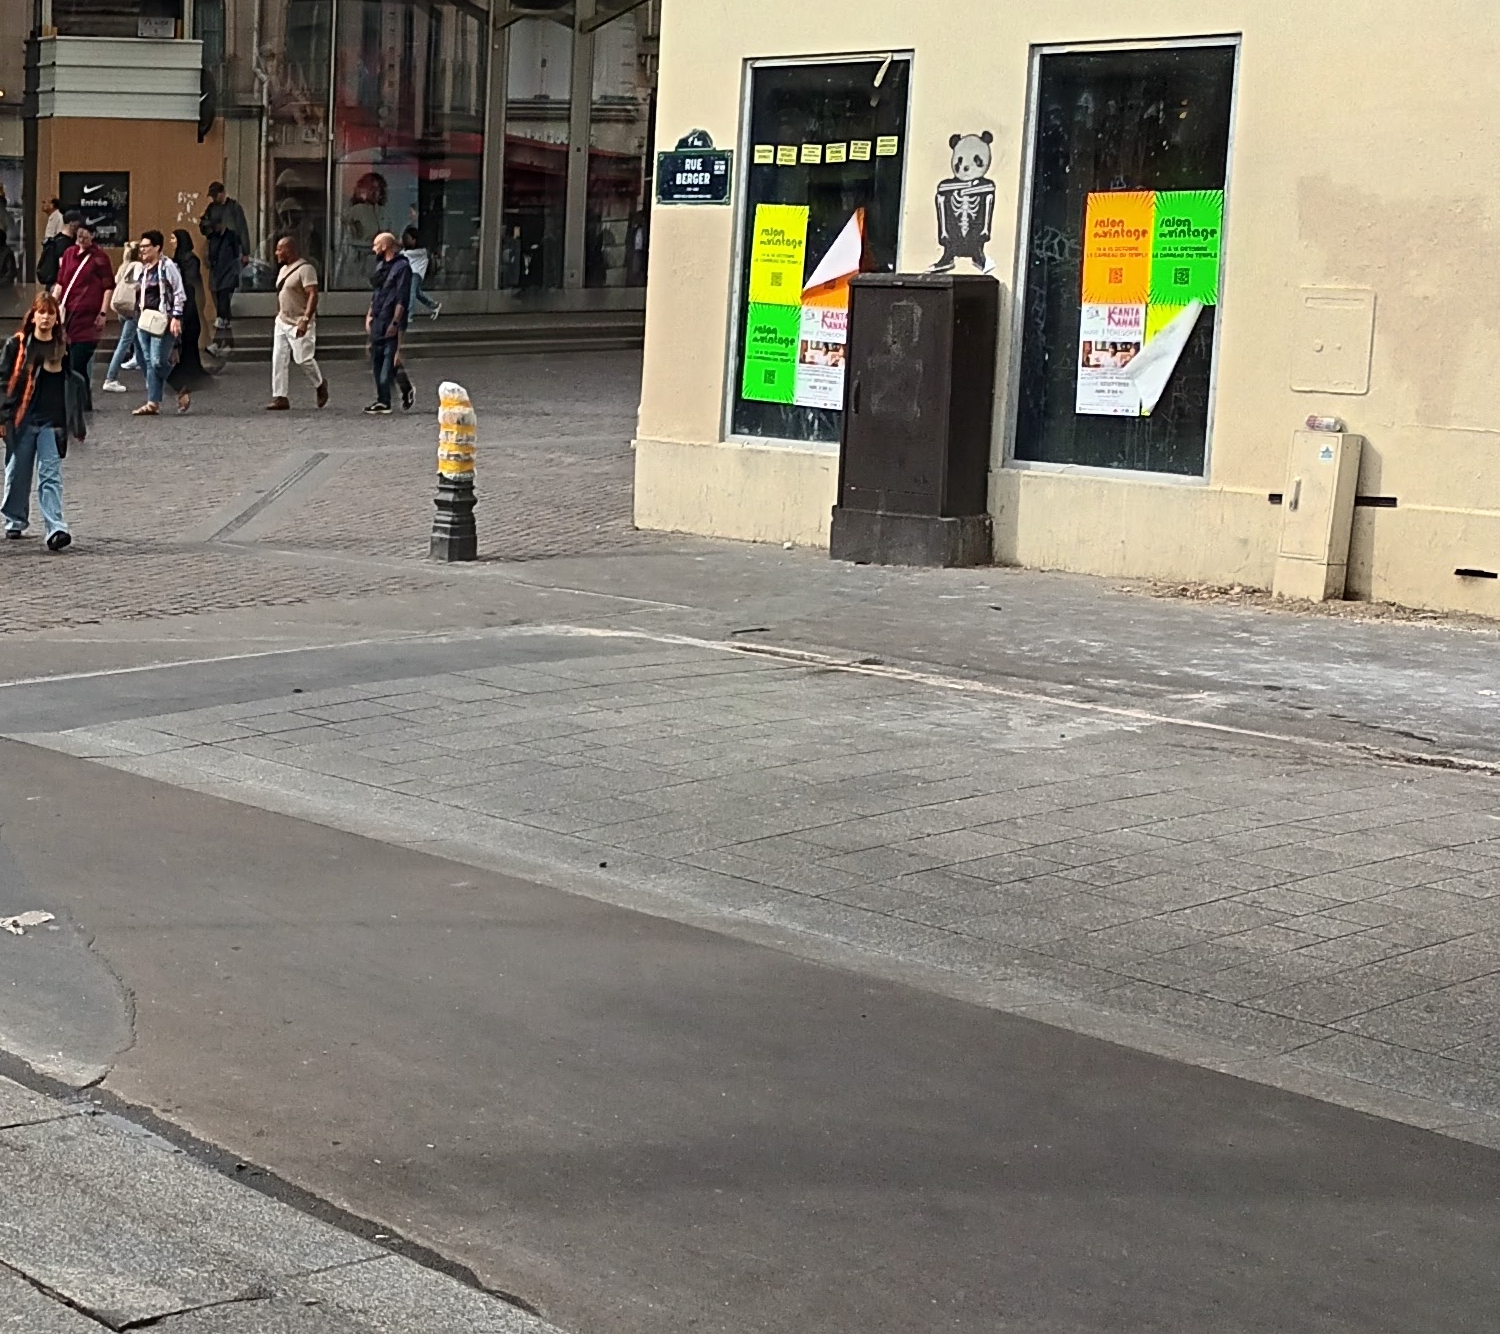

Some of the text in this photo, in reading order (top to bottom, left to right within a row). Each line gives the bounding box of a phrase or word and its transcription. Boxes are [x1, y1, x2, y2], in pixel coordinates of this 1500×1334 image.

[685, 158, 703, 171] RUE
[675, 172, 711, 185] BERGER
[80, 197, 108, 207] Entrée
[1094, 217, 1125, 229] salon
[1159, 216, 1191, 229] salon
[1102, 228, 1149, 241] vintage
[1167, 227, 1218, 242] vintage
